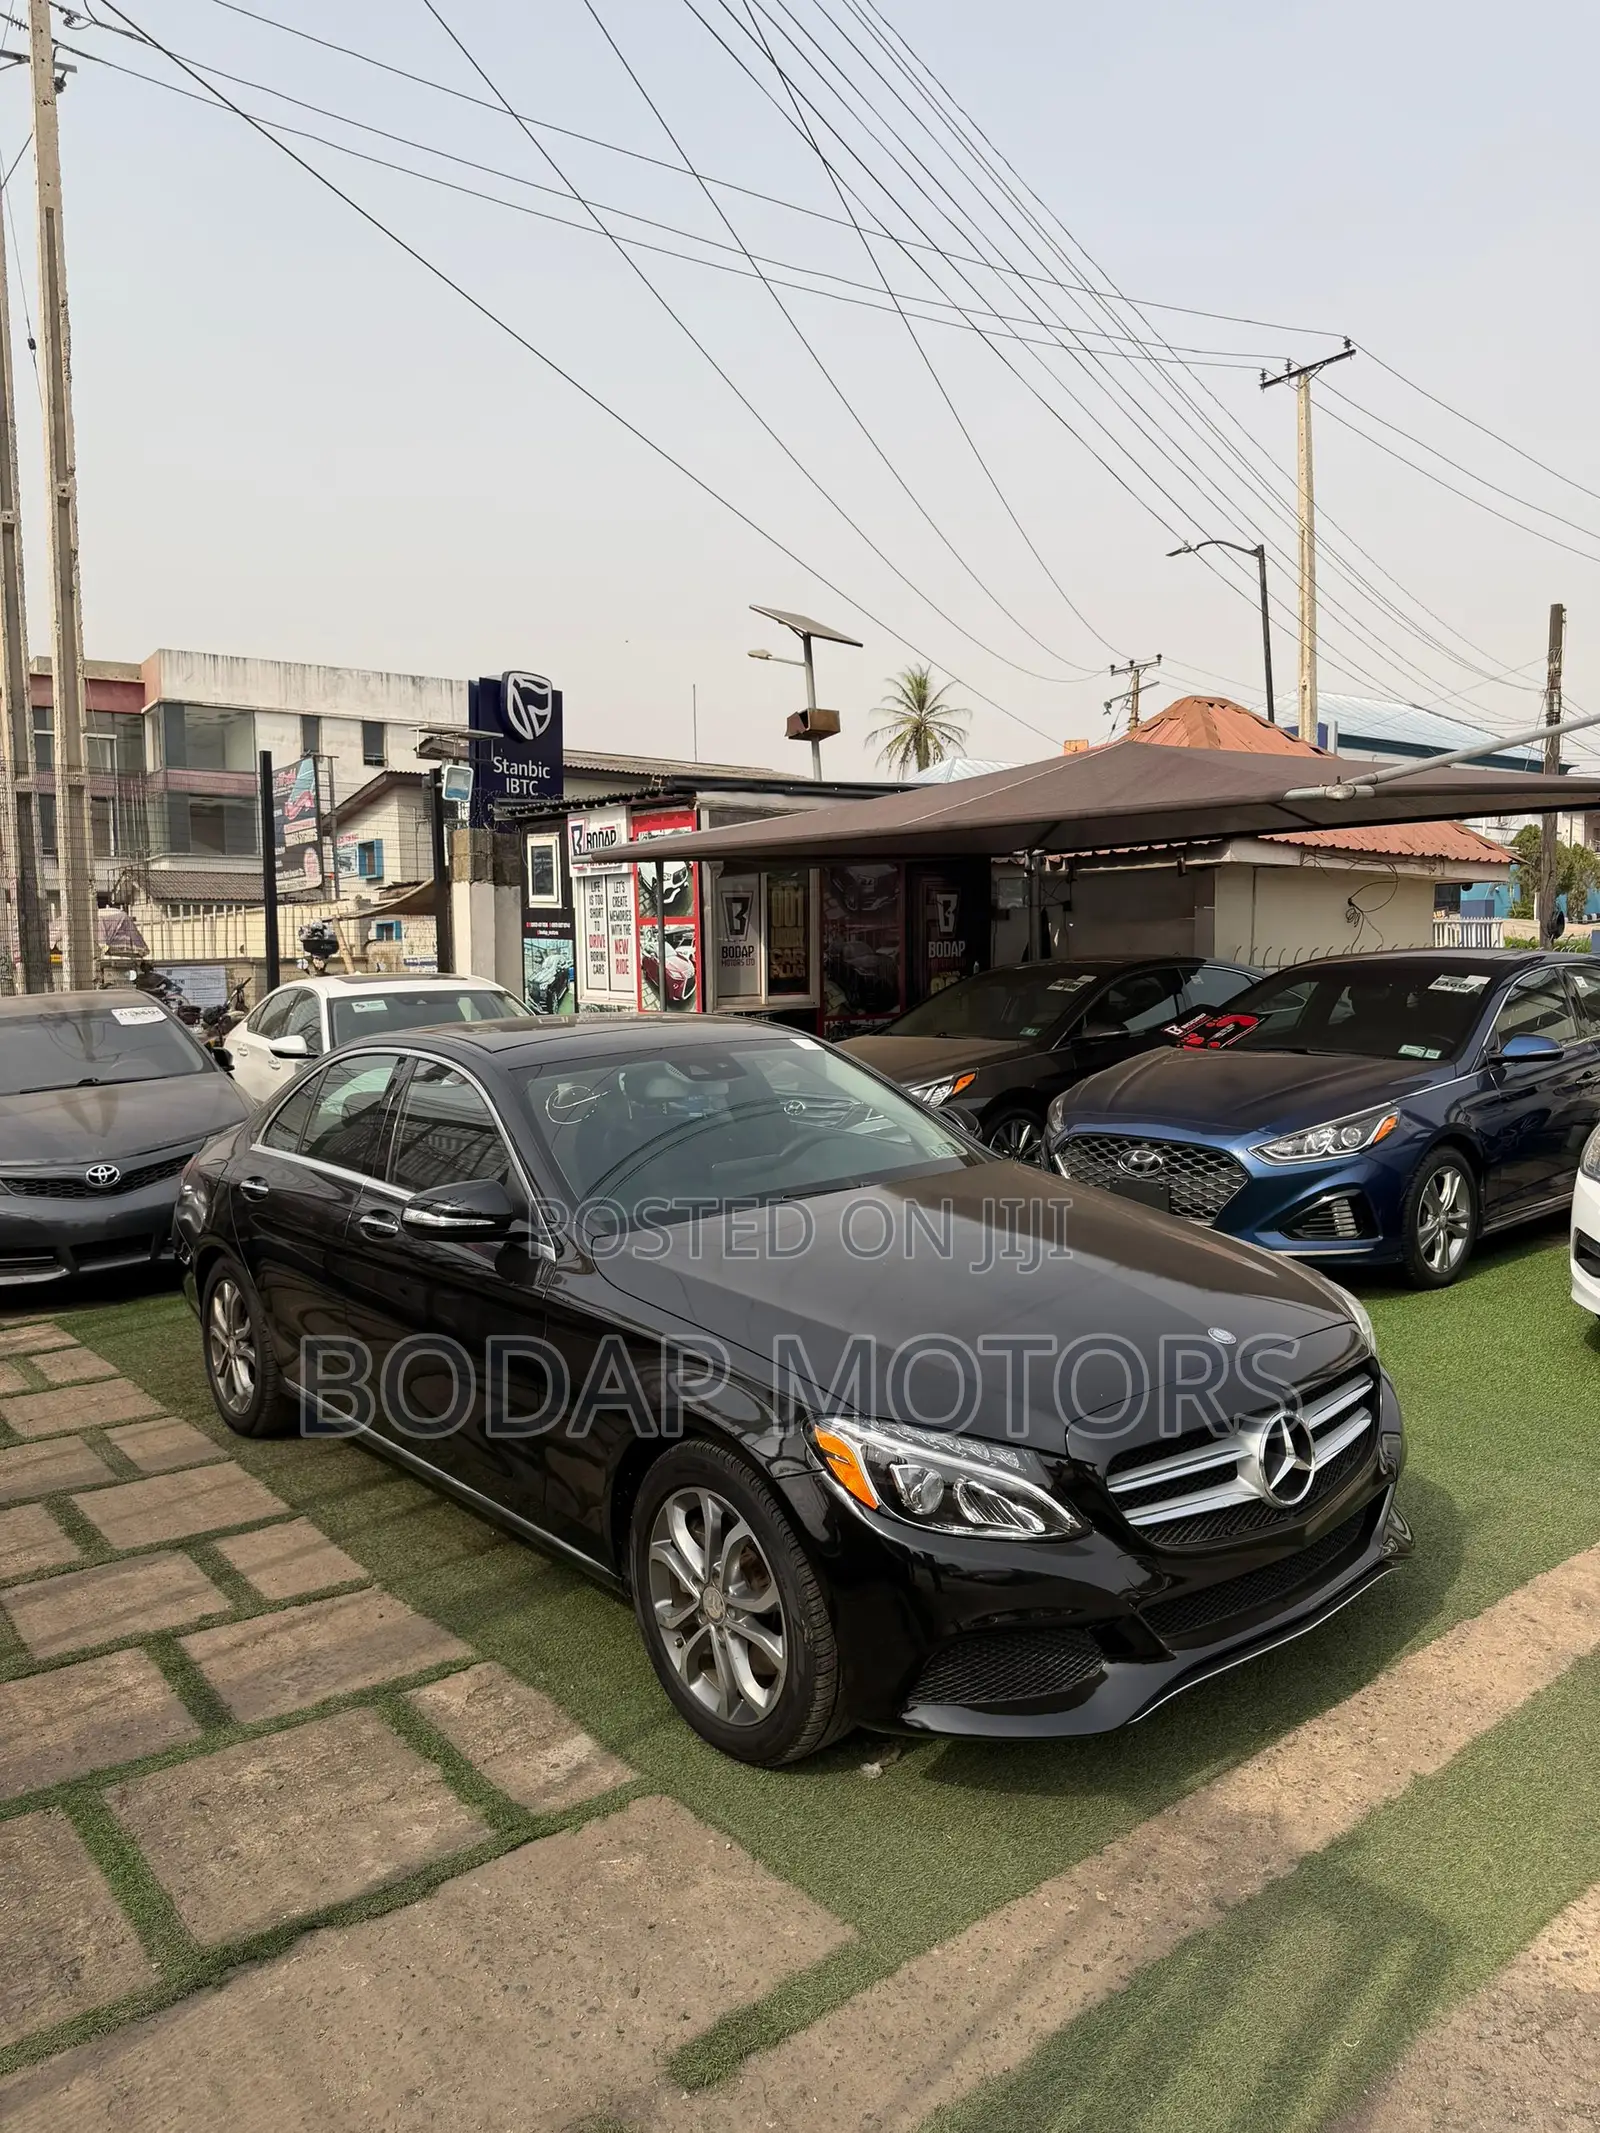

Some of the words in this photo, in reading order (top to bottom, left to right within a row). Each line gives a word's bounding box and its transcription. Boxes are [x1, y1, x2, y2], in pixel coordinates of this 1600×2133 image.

[493, 756, 551, 779] Stanbic
[506, 777, 539, 796] IBTC
[590, 881, 601, 892] LIFE
[612, 896, 628, 907] CREATE
[590, 908, 604, 918] SHORT
[609, 910, 632, 921] MEMORIES
[594, 921, 600, 931] TO
[589, 934, 605, 948] DRIVE
[615, 939, 629, 954] NEW
[721, 945, 755, 959] BODAP
[928, 940, 966, 958] BODAP
[593, 965, 605, 974] CARS
[616, 959, 629, 974] RIDE
